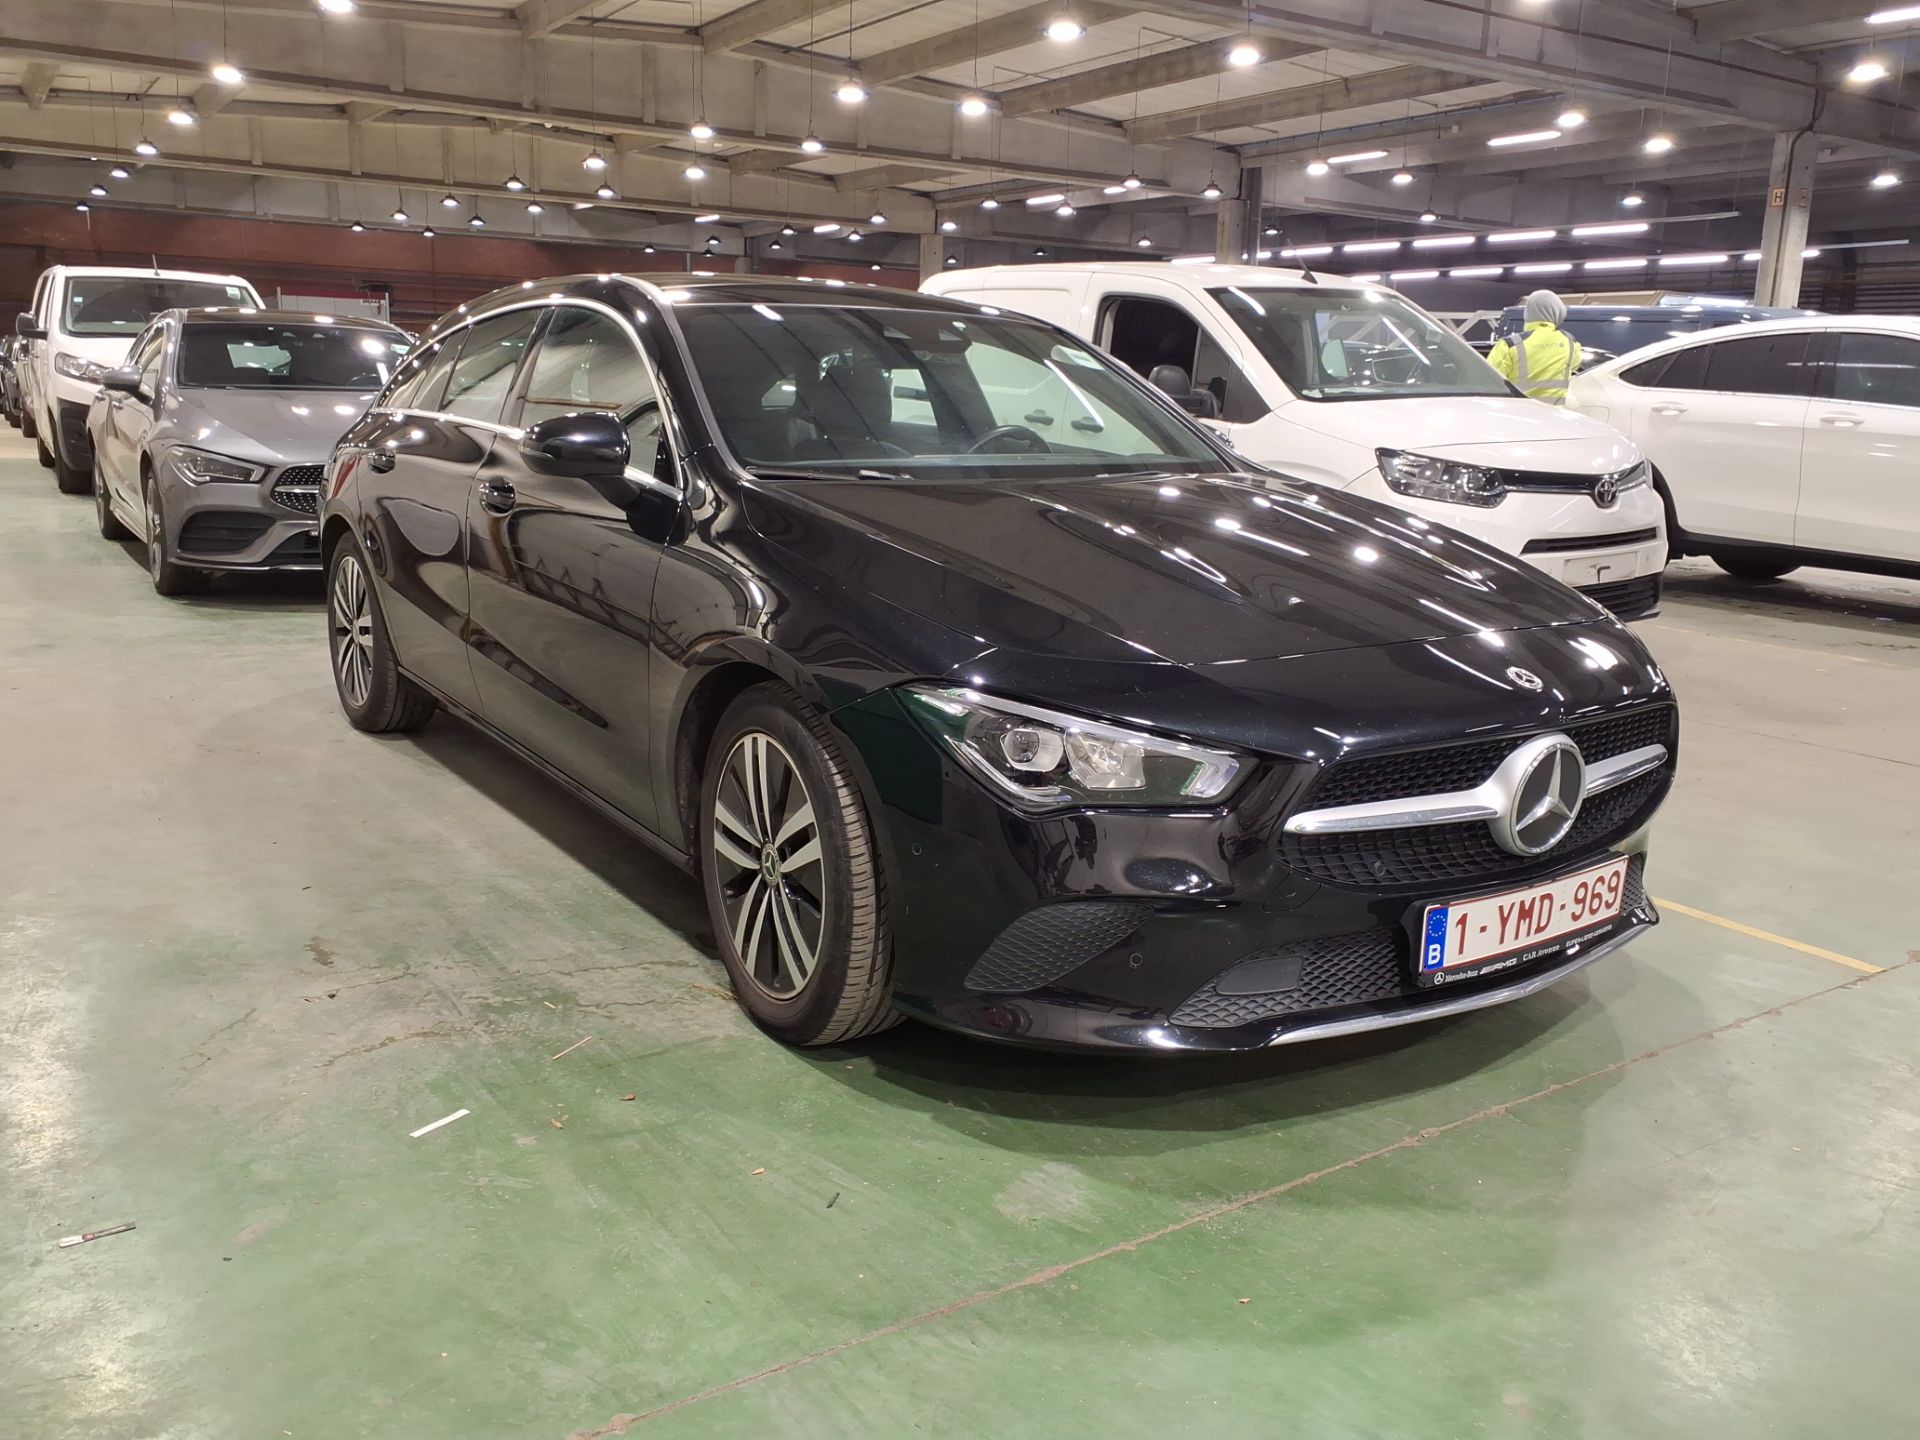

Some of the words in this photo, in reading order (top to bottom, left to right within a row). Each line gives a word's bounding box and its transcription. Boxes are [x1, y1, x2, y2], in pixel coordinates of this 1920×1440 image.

[1774, 191, 1783, 204] H
[1455, 870, 1621, 955] 1-YMD-969
[1428, 944, 1441, 965] B
